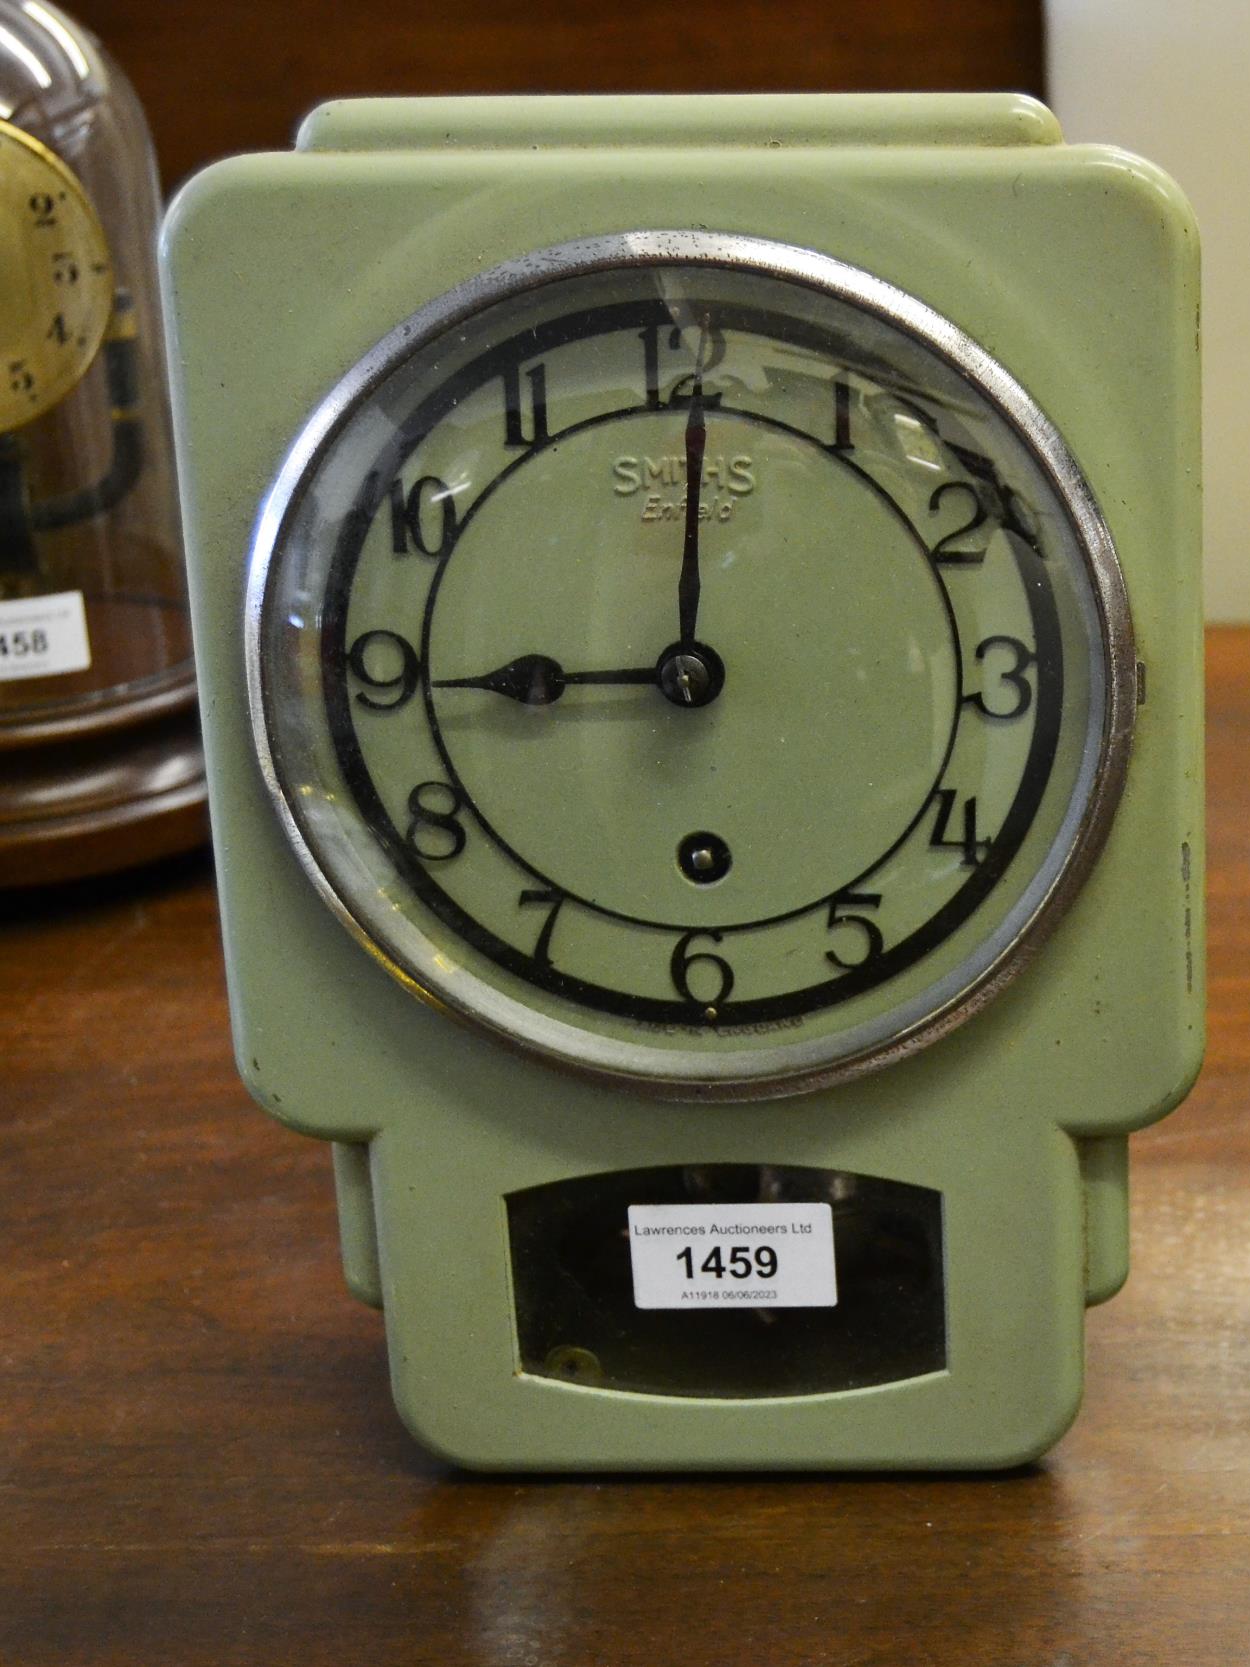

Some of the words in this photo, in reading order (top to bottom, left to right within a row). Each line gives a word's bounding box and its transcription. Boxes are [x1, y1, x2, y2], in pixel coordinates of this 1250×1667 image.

[29, 192, 56, 227] 2
[46, 312, 70, 346] 4
[638, 322, 728, 411] 12
[500, 362, 548, 446] 11
[828, 372, 855, 449] 1
[386, 476, 456, 556] 10
[929, 482, 988, 563] 2
[349, 629, 418, 710] 9
[966, 635, 1035, 719] 3
[406, 781, 466, 860] 8
[930, 789, 992, 866] 4
[519, 890, 566, 967] 7
[670, 930, 734, 1003] 6
[825, 893, 883, 969] 5
[634, 1225, 706, 1236] Lawrences
[710, 1223, 787, 1235] Auctioneers
[792, 1223, 812, 1234] Ltd
[676, 1245, 778, 1279] 1459
[681, 1291, 719, 1300] A11918
[722, 1290, 777, 1300] 06/06/2023
